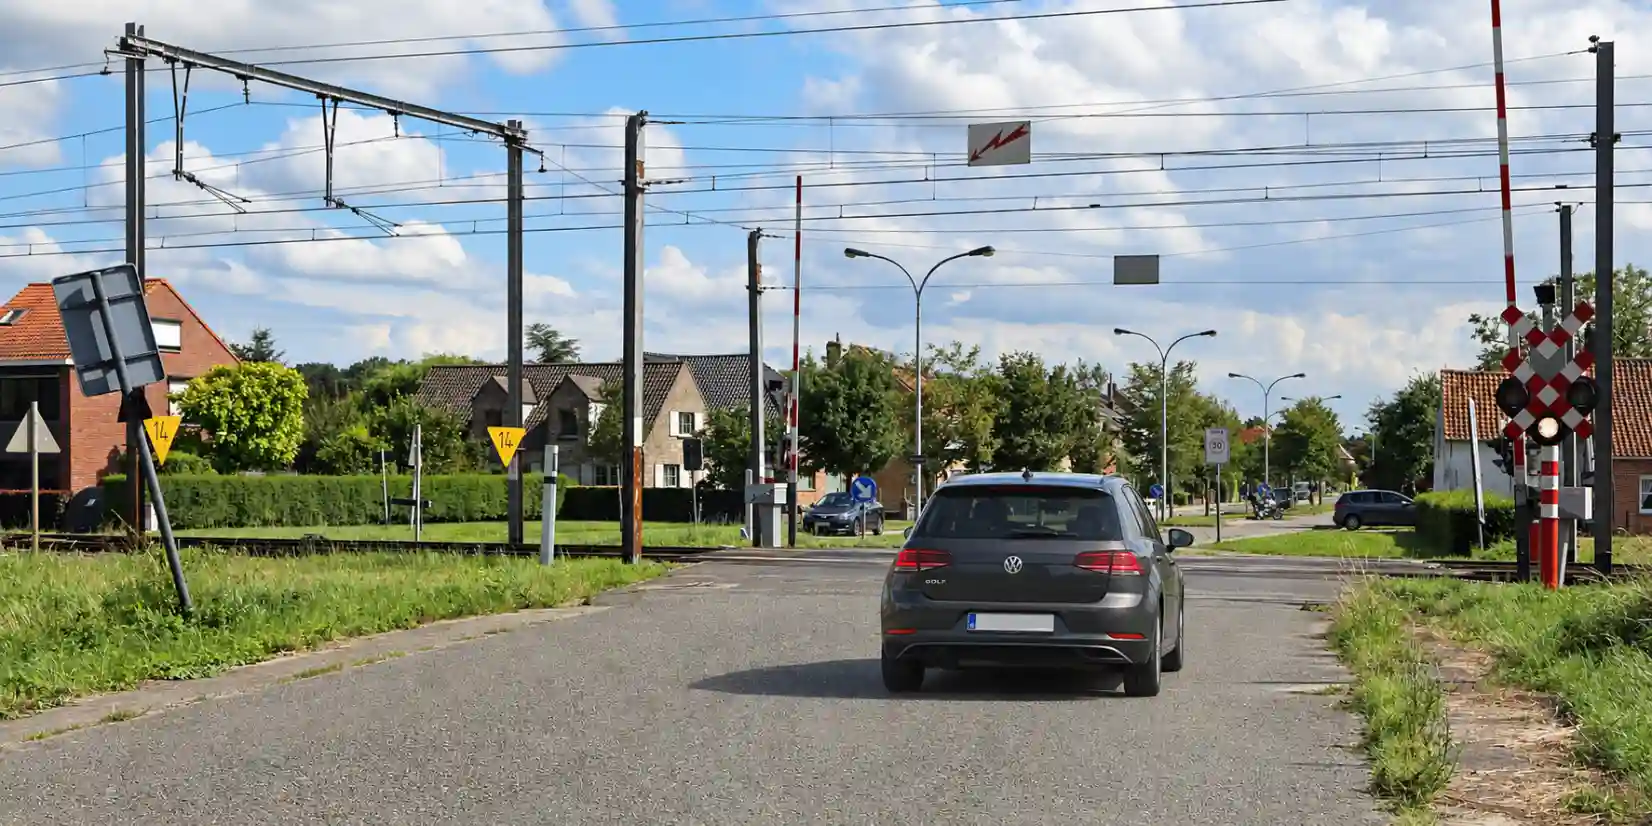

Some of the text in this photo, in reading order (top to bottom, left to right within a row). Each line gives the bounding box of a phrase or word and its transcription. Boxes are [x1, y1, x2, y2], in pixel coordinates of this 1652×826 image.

[153, 421, 168, 440] 14
[499, 431, 513, 448] 14
[1004, 555, 1022, 573] VW
